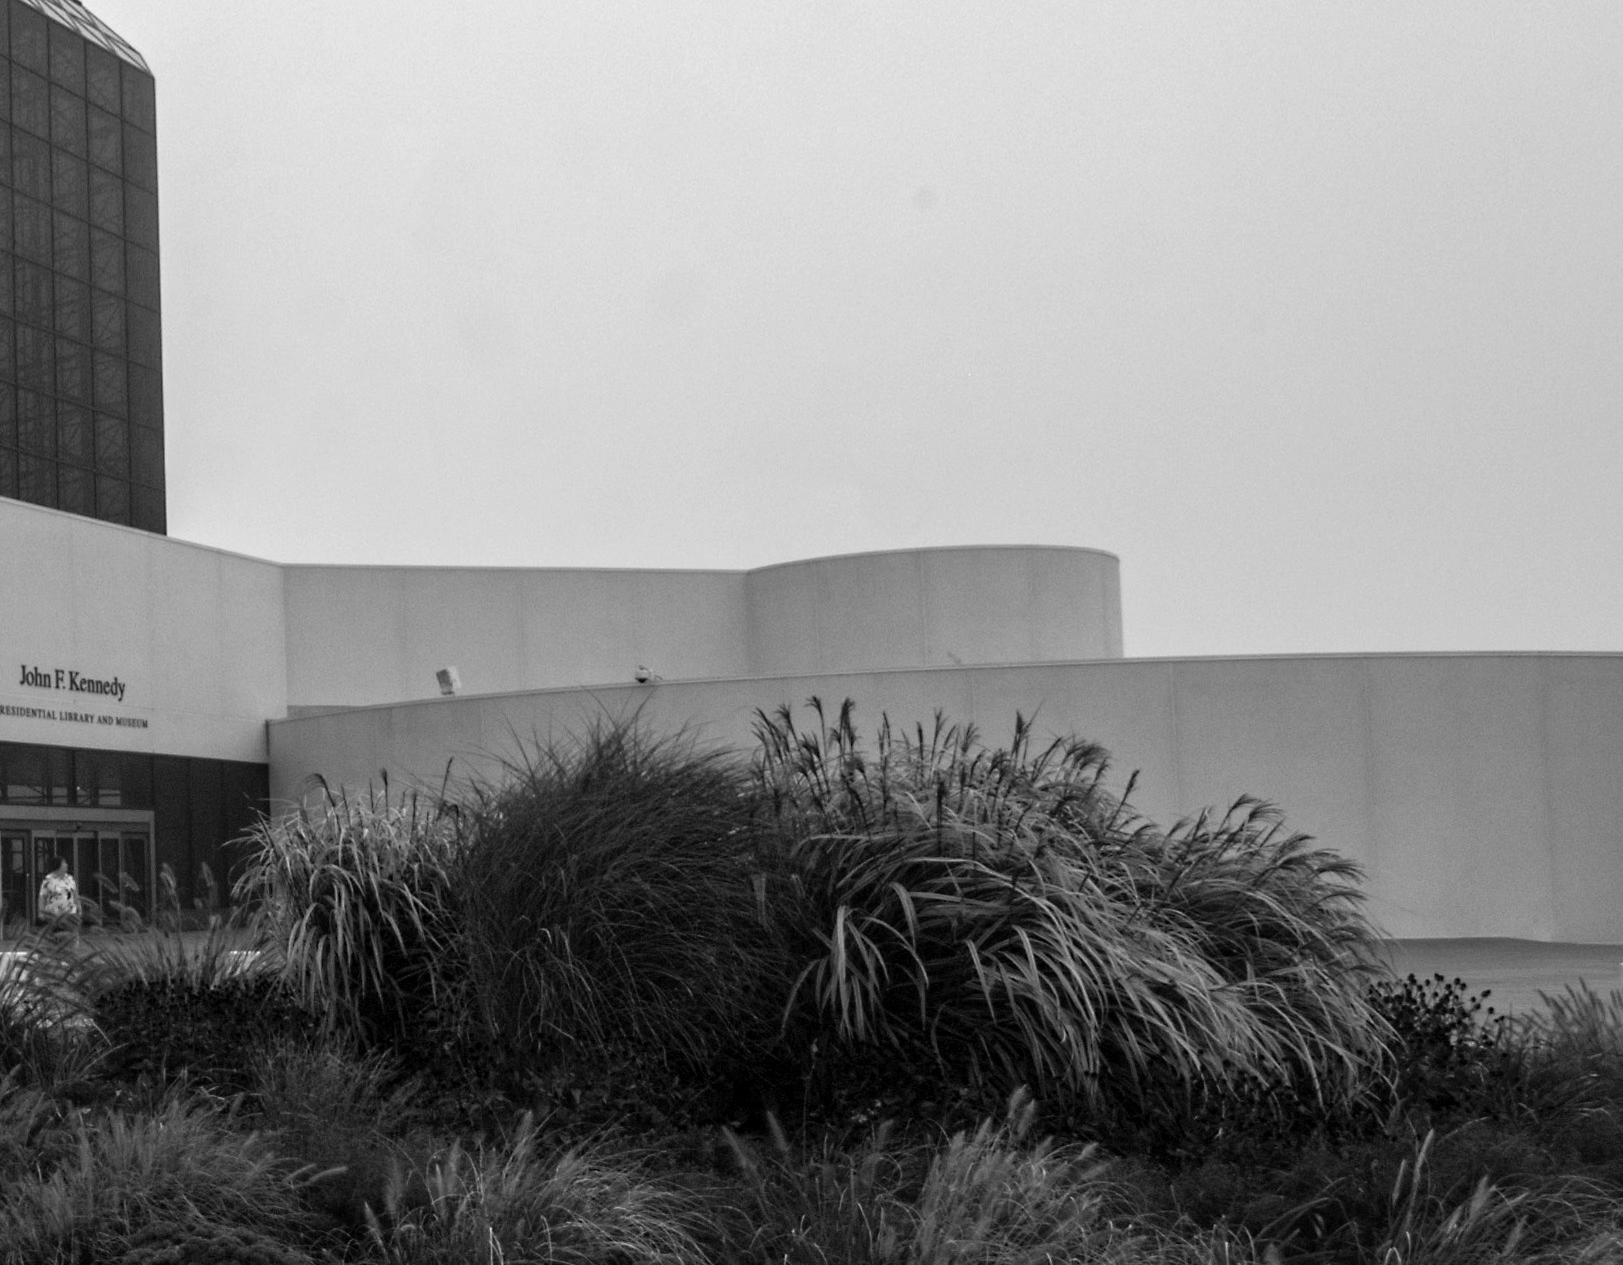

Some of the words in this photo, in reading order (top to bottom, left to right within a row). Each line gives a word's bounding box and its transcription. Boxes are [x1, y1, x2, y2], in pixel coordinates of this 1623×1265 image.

[19, 665, 52, 688] John
[55, 669, 66, 689] F.
[68, 671, 126, 702] Kennedy
[59, 711, 94, 724] LIBRARY
[97, 715, 114, 726] AND
[115, 717, 148, 729] MUSEUM
